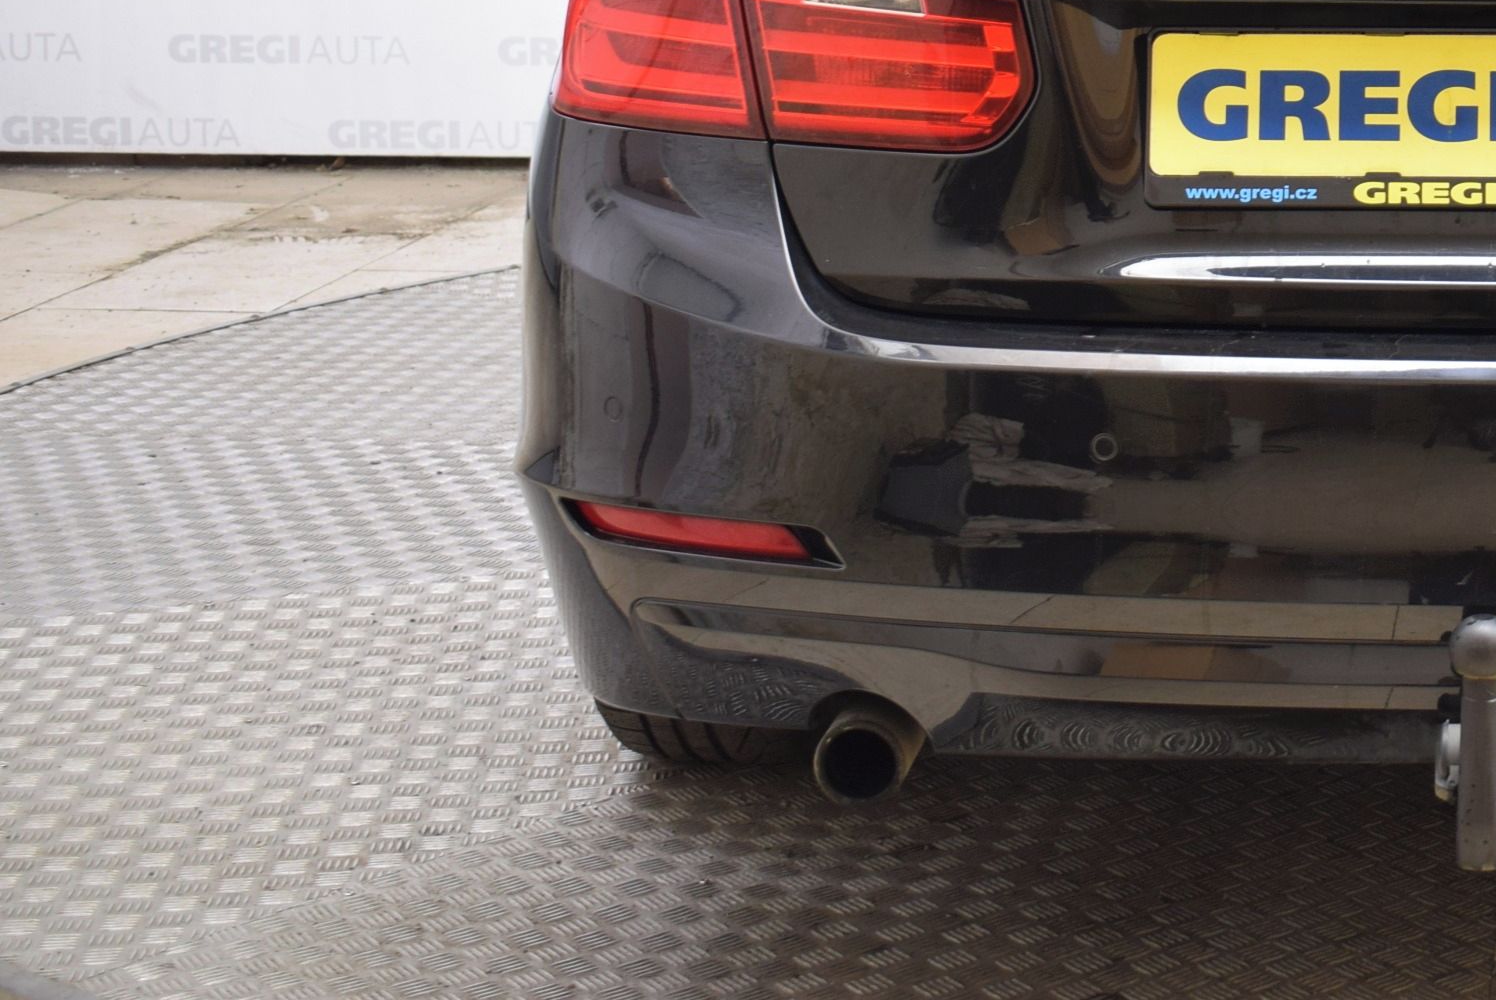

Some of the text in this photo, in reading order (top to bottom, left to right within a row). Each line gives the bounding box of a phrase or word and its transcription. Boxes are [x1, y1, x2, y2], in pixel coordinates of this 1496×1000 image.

[167, 34, 411, 67] GREGIAUTA
[1, 115, 241, 149] GREGIAUTA
[1185, 185, 1317, 203] www.gregi.cz
